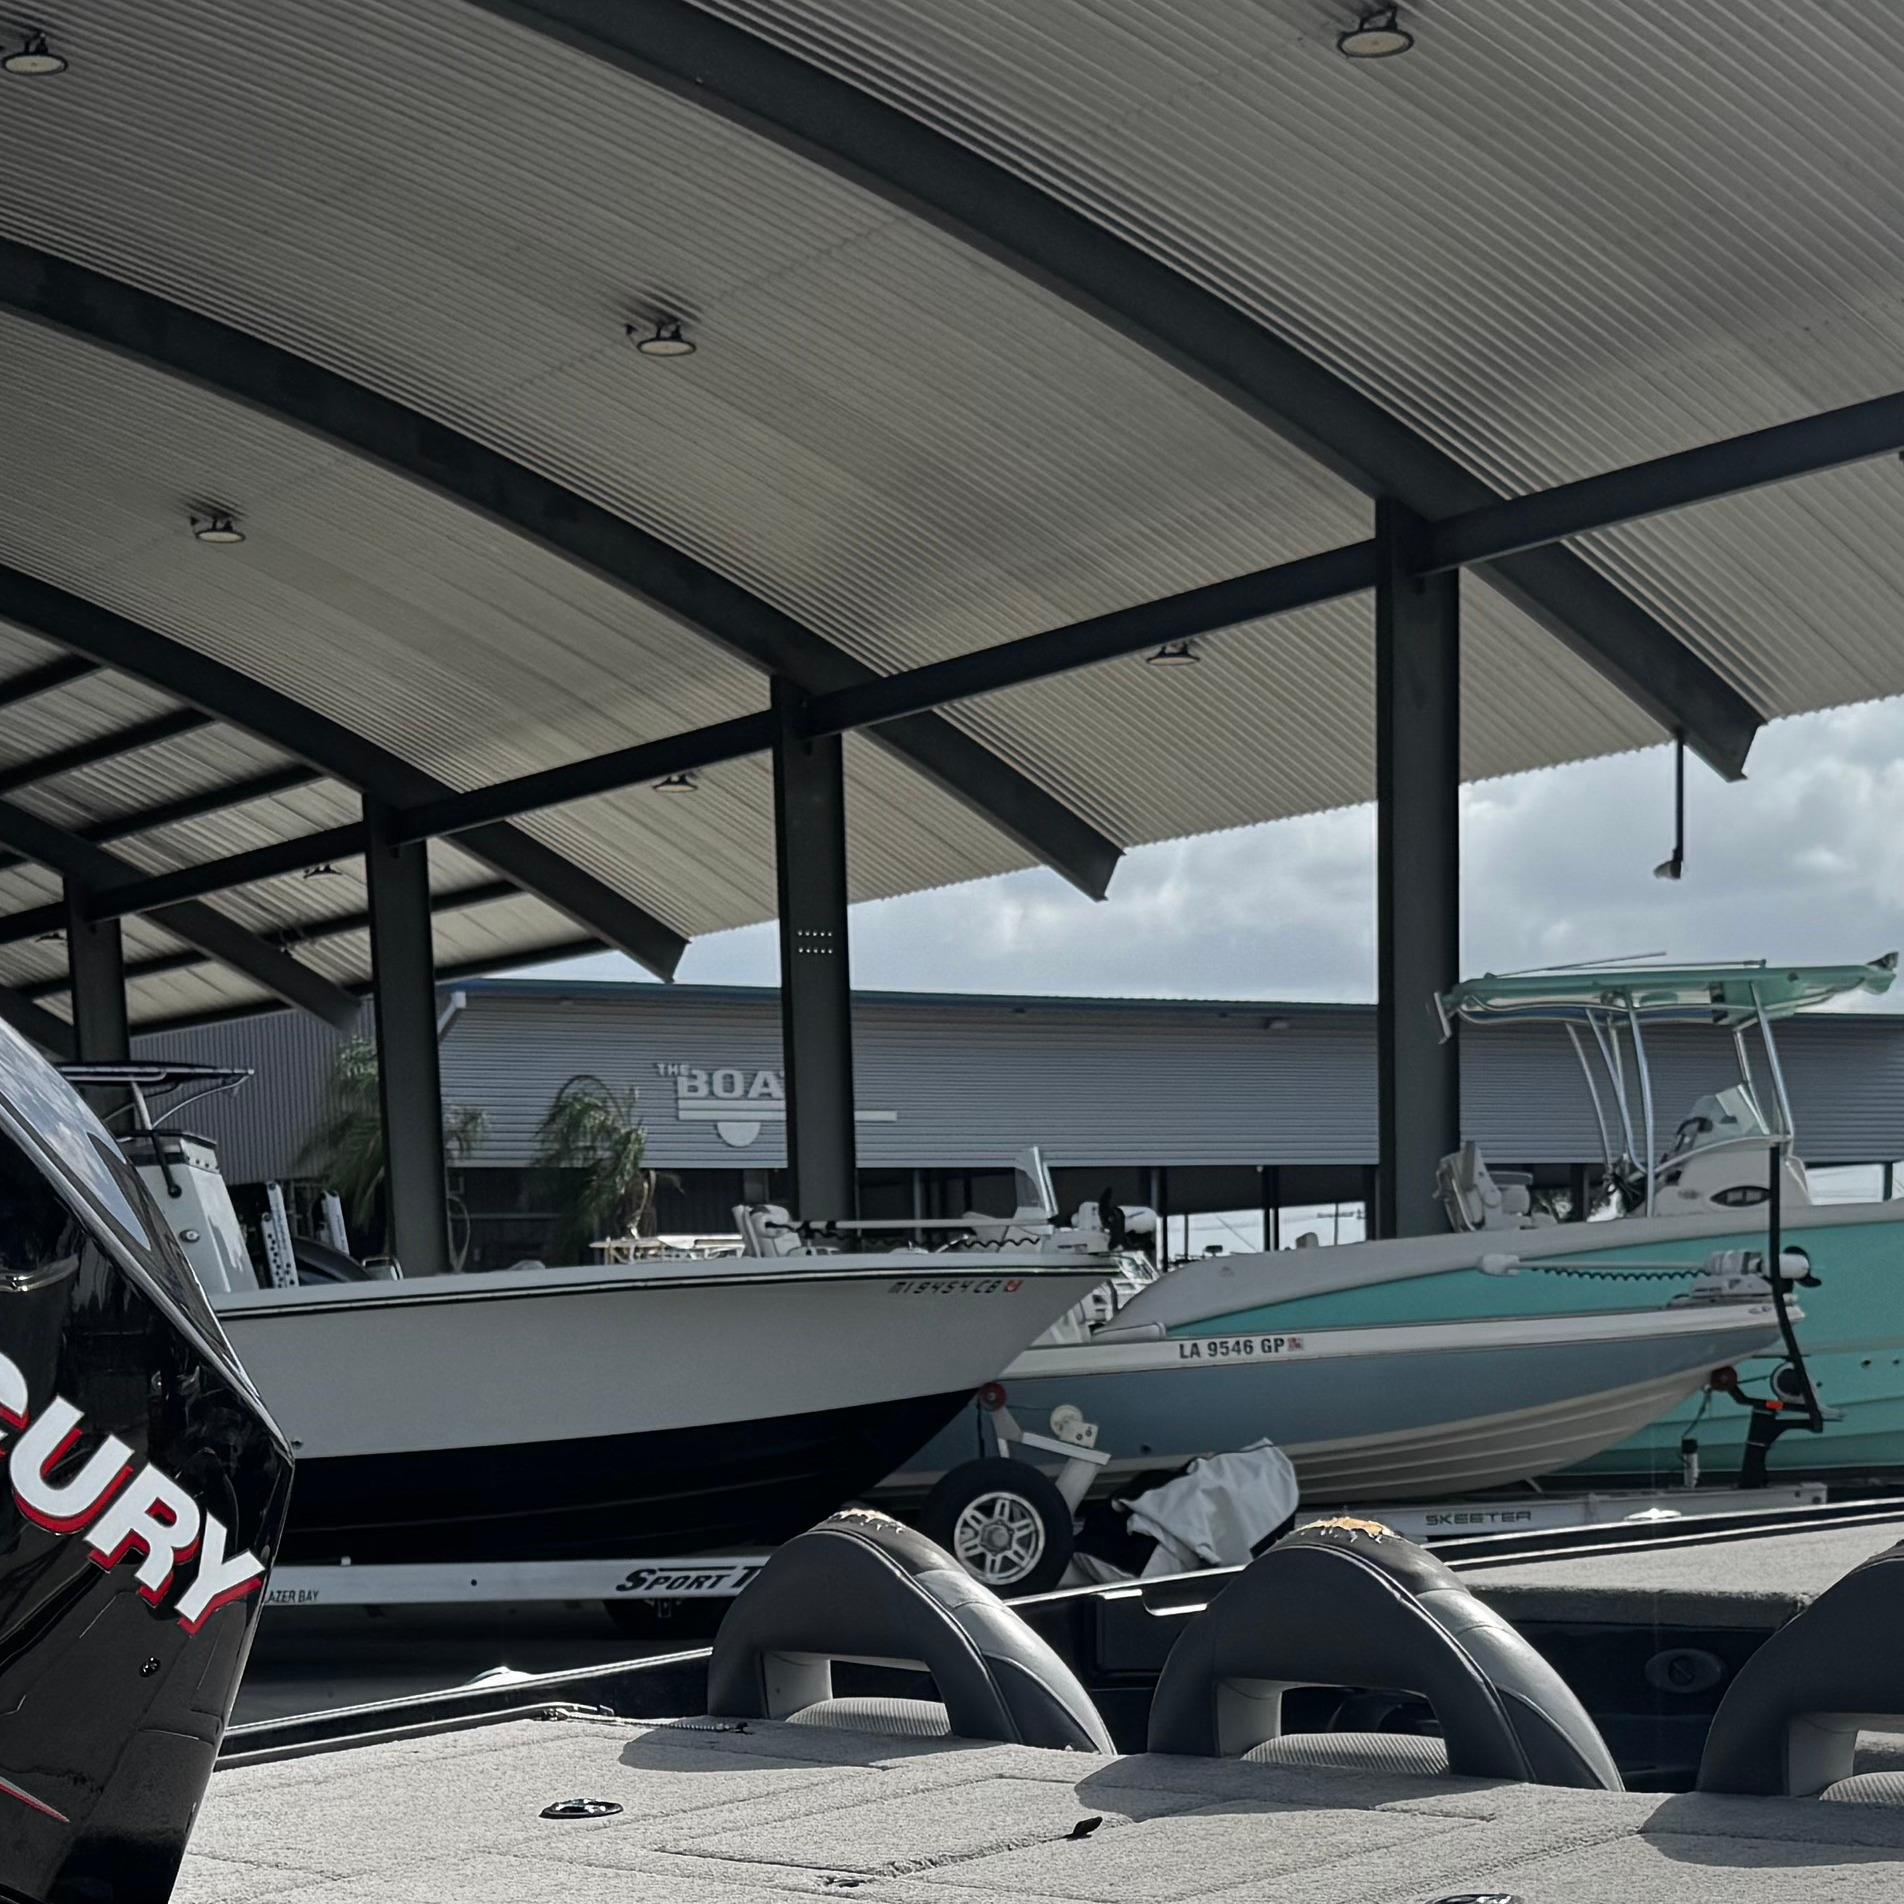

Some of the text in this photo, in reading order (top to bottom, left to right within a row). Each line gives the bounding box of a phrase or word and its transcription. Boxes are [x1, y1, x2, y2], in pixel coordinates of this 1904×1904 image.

[656, 1062, 786, 1099] THE BOA
[1179, 1337, 1284, 1360] LA 9546 GP
[1425, 1511, 1532, 1526] SKEETER
[298, 1588, 320, 1602] BAY
